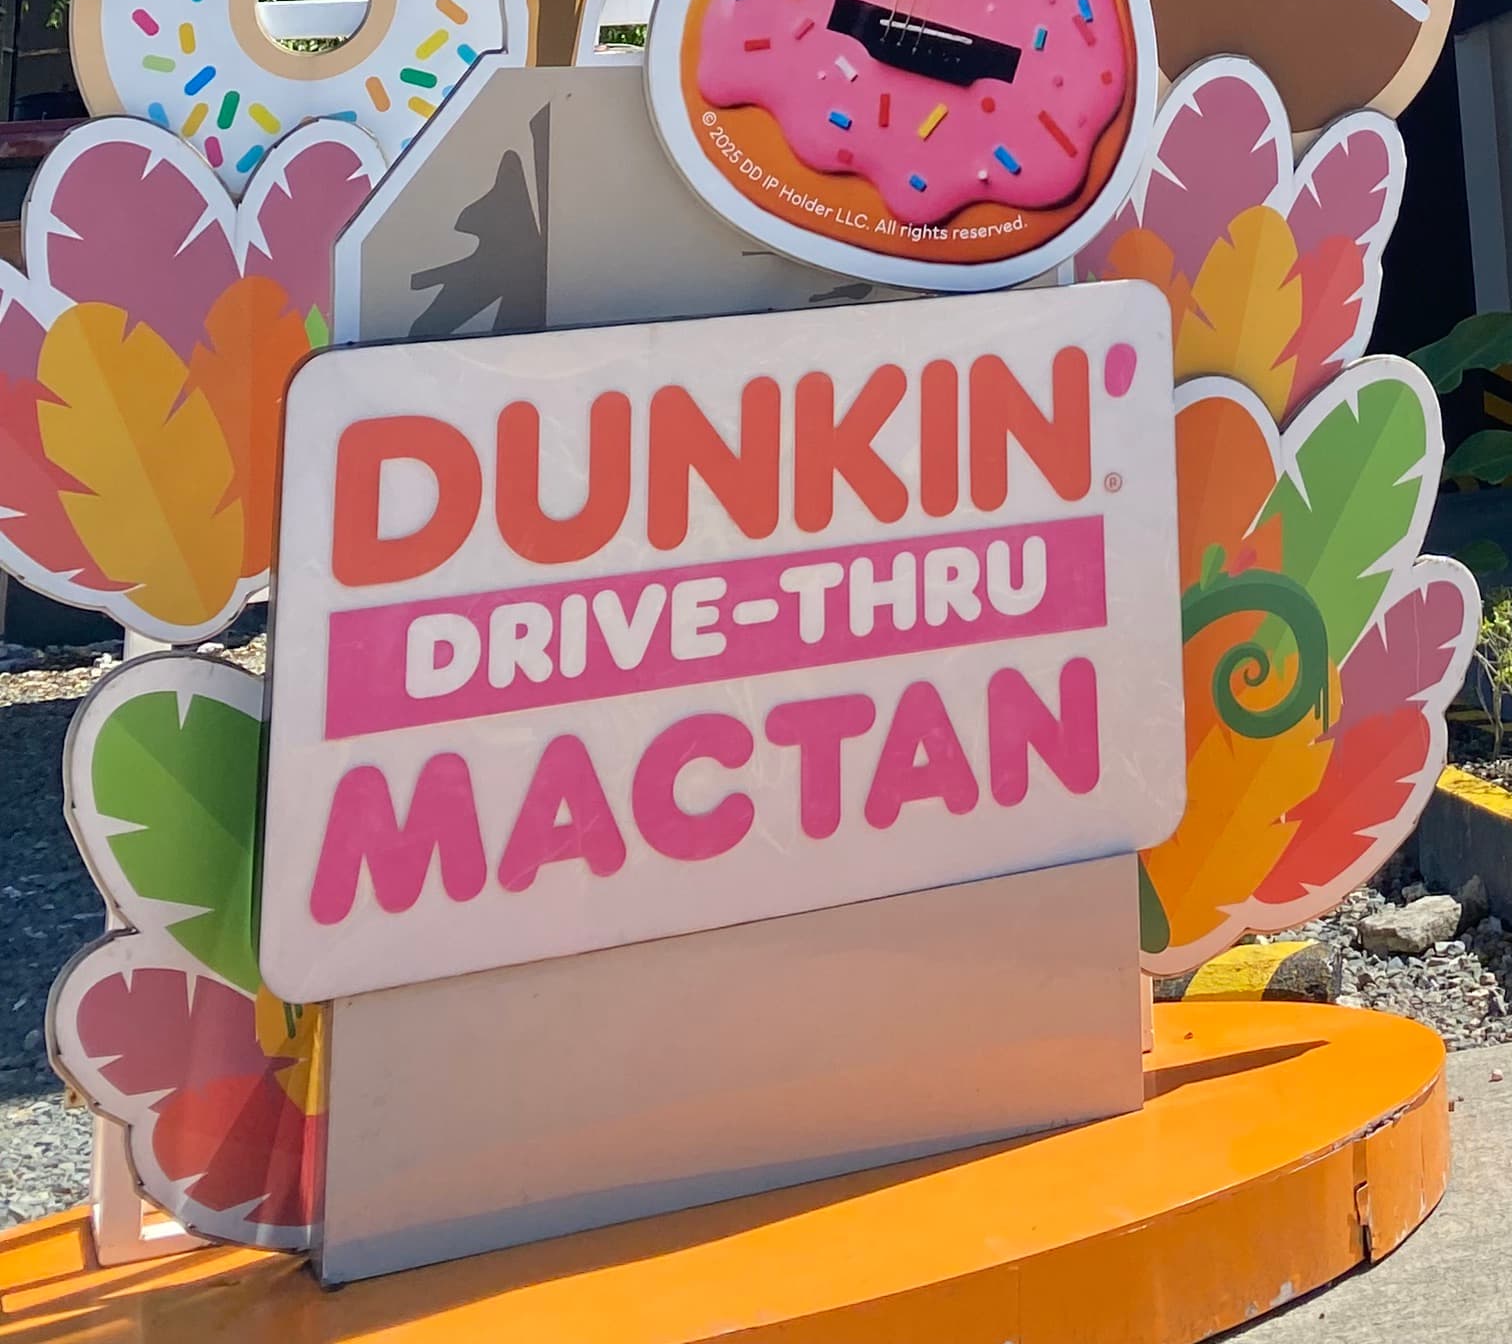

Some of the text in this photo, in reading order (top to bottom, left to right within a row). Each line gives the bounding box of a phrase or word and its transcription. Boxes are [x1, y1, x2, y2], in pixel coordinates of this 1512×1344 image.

[709, 126, 743, 164] 2025
[739, 158, 763, 181] DD
[762, 175, 779, 191] IP
[778, 184, 834, 218] Holder
[835, 209, 870, 230] LLC.
[874, 219, 897, 235] All
[900, 223, 948, 242] rights
[952, 215, 1029, 240] reserved.
[331, 341, 1138, 588] DUNKIN'
[404, 534, 1048, 700] DRIVE-THRU
[309, 655, 1102, 926] MACTAN
